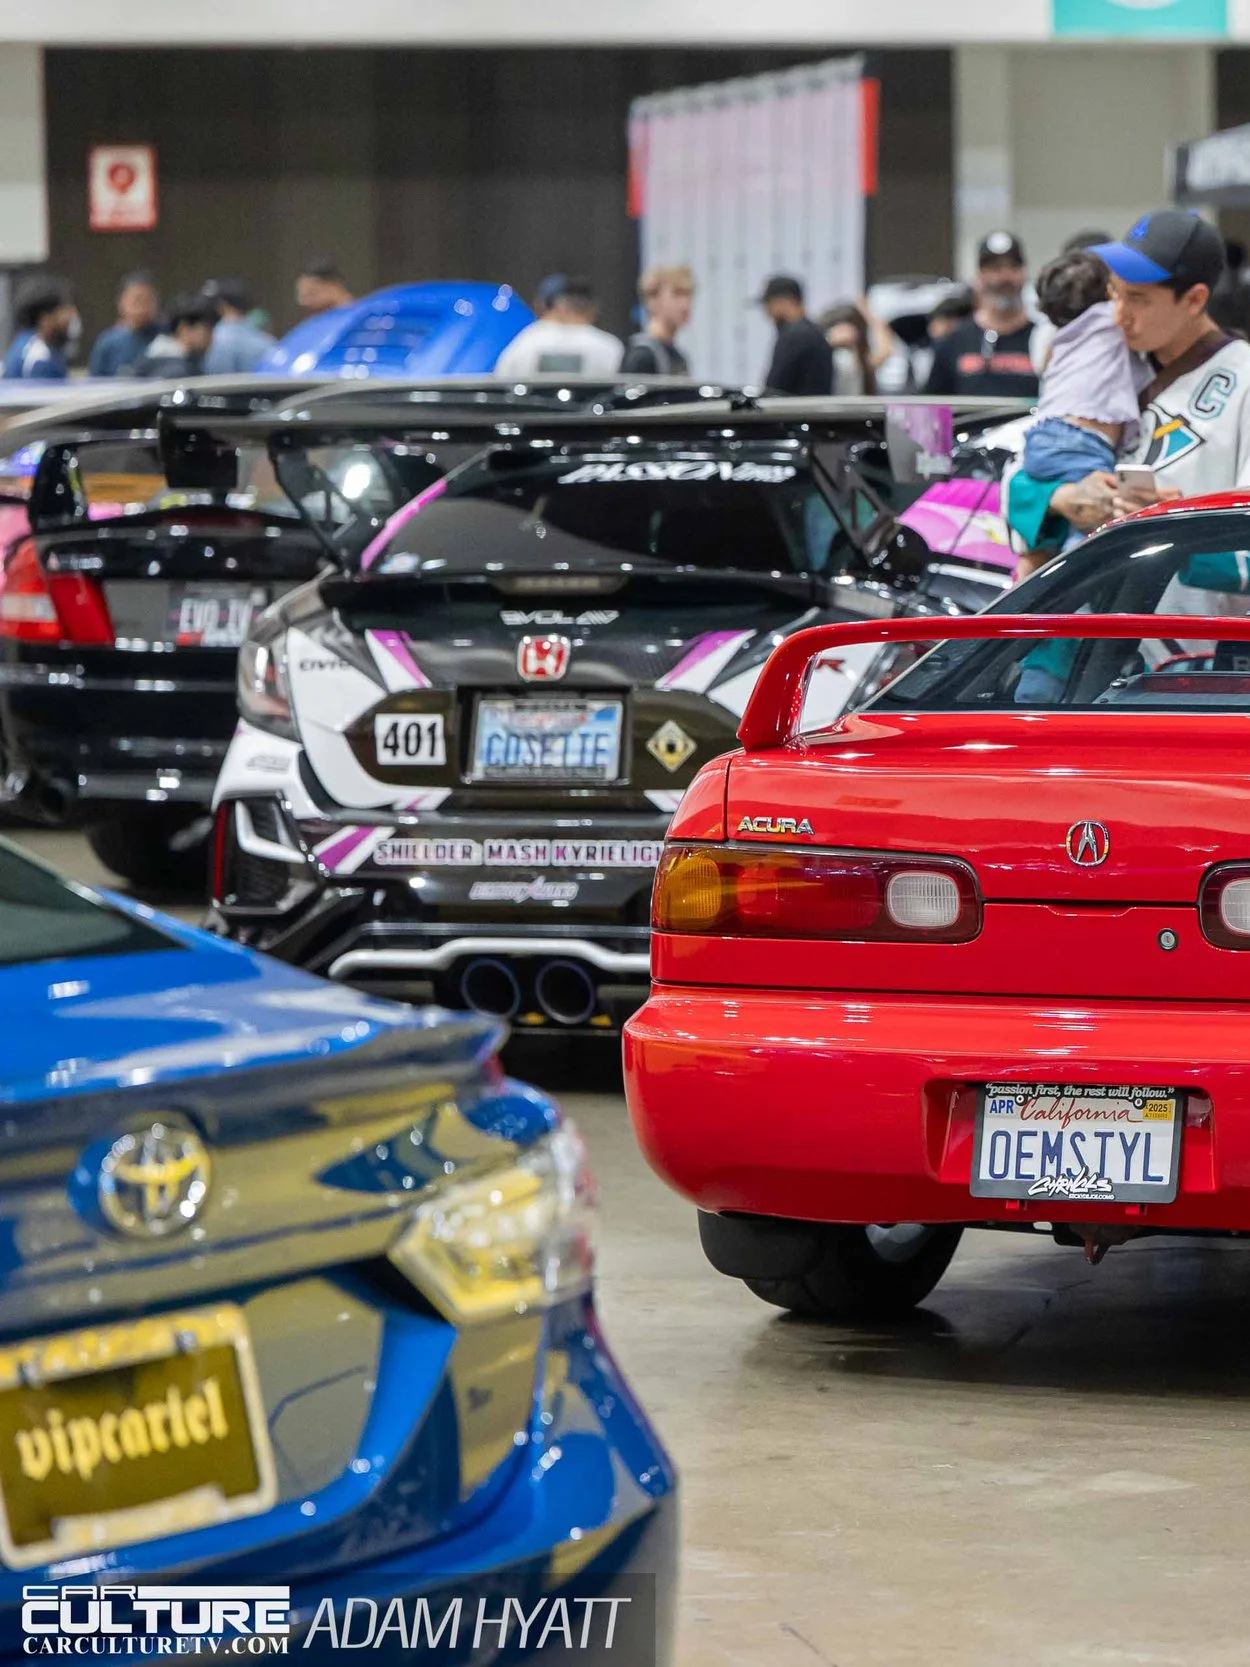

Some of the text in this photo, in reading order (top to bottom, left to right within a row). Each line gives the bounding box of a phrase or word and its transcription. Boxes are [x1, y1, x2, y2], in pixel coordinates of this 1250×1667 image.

[1188, 367, 1237, 420] C
[383, 722, 438, 758] 401
[737, 816, 815, 835] ACURA
[488, 845, 546, 861] MASH
[1033, 1084, 1061, 1098] first,
[1063, 1085, 1082, 1096] the
[1084, 1087, 1107, 1096] rest
[1108, 1086, 1130, 1097] will
[989, 1099, 1014, 1114] APR
[1020, 1097, 1144, 1129] California
[1148, 1103, 1168, 1113] 2025
[988, 1130, 1164, 1182] OEMSTYL
[15, 1375, 229, 1482] vipcartel
